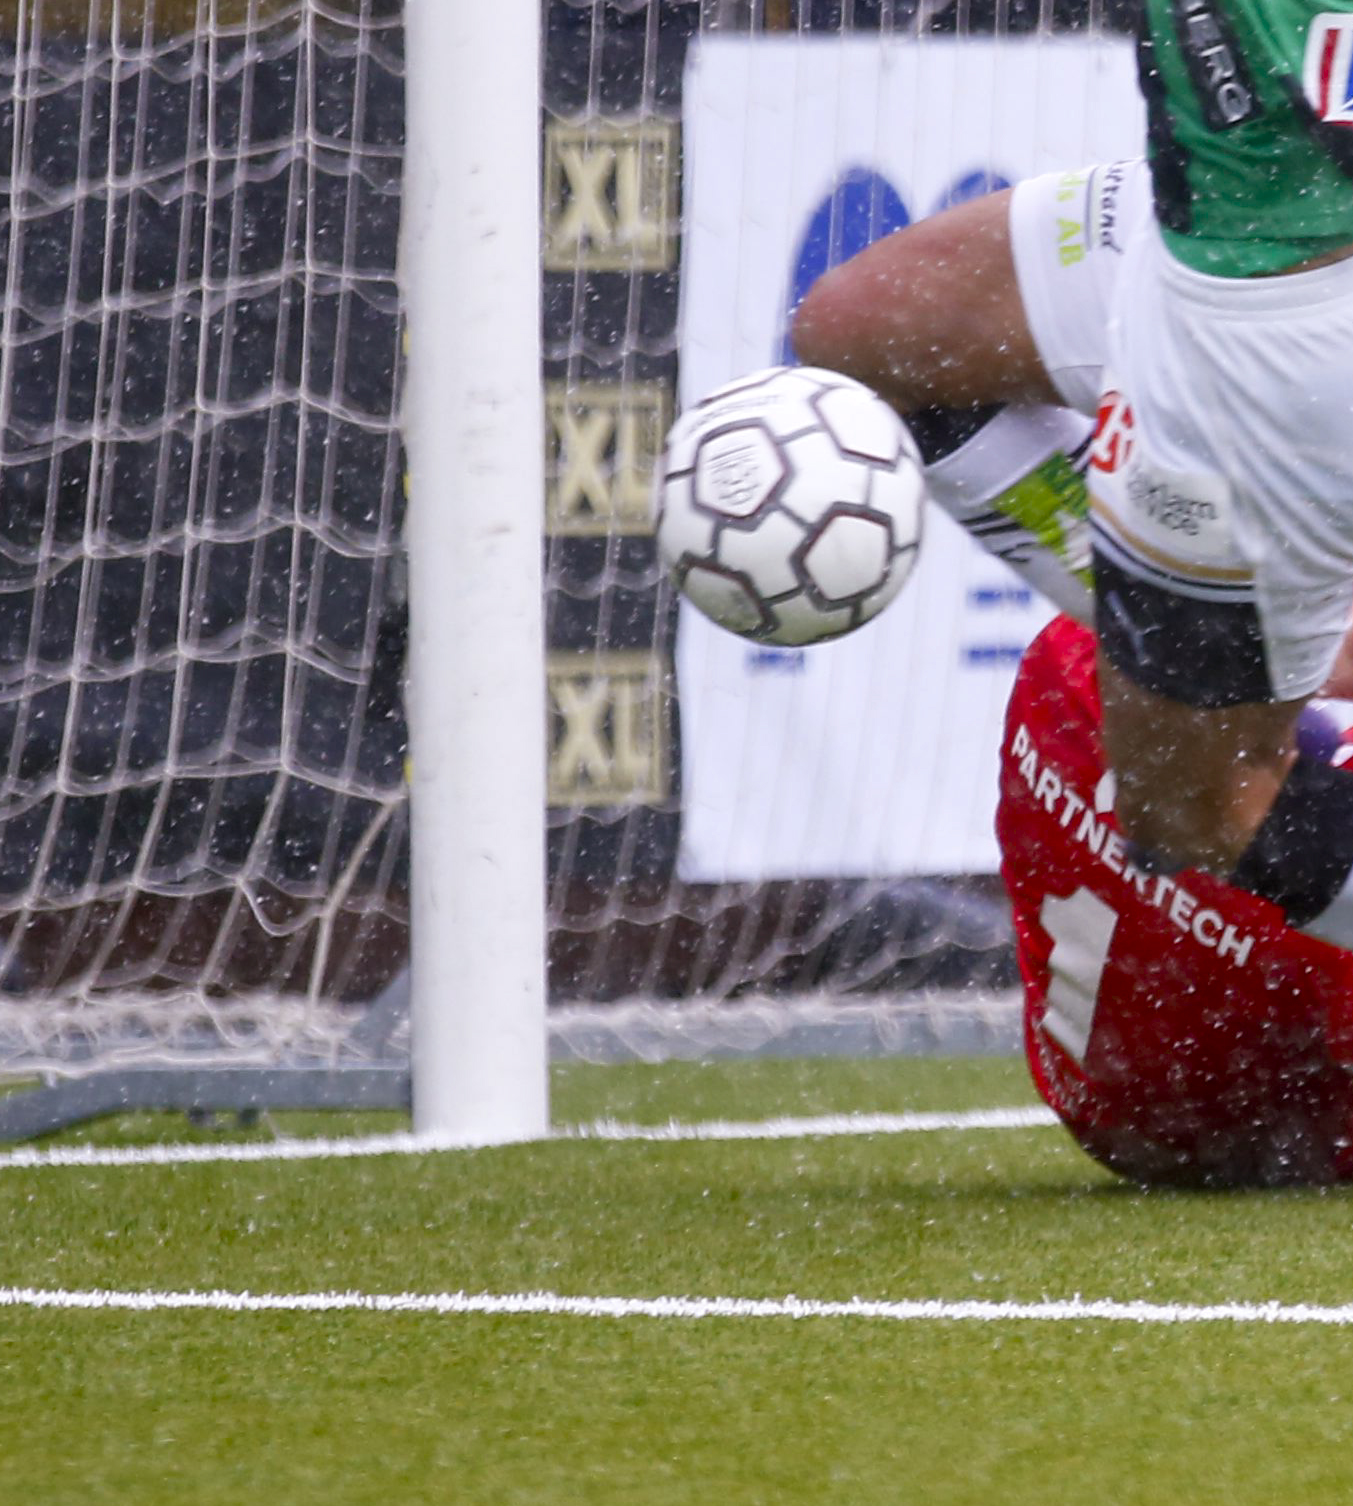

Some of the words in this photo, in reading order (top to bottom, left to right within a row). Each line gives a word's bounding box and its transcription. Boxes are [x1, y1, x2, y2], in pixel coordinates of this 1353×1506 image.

[548, 144, 662, 251] XL
[1056, 217, 1086, 268] AB
[550, 409, 658, 518] XL
[552, 676, 652, 784] XL
[1012, 724, 1255, 968] PARTNERTECH
[1039, 885, 1119, 1063] 1
